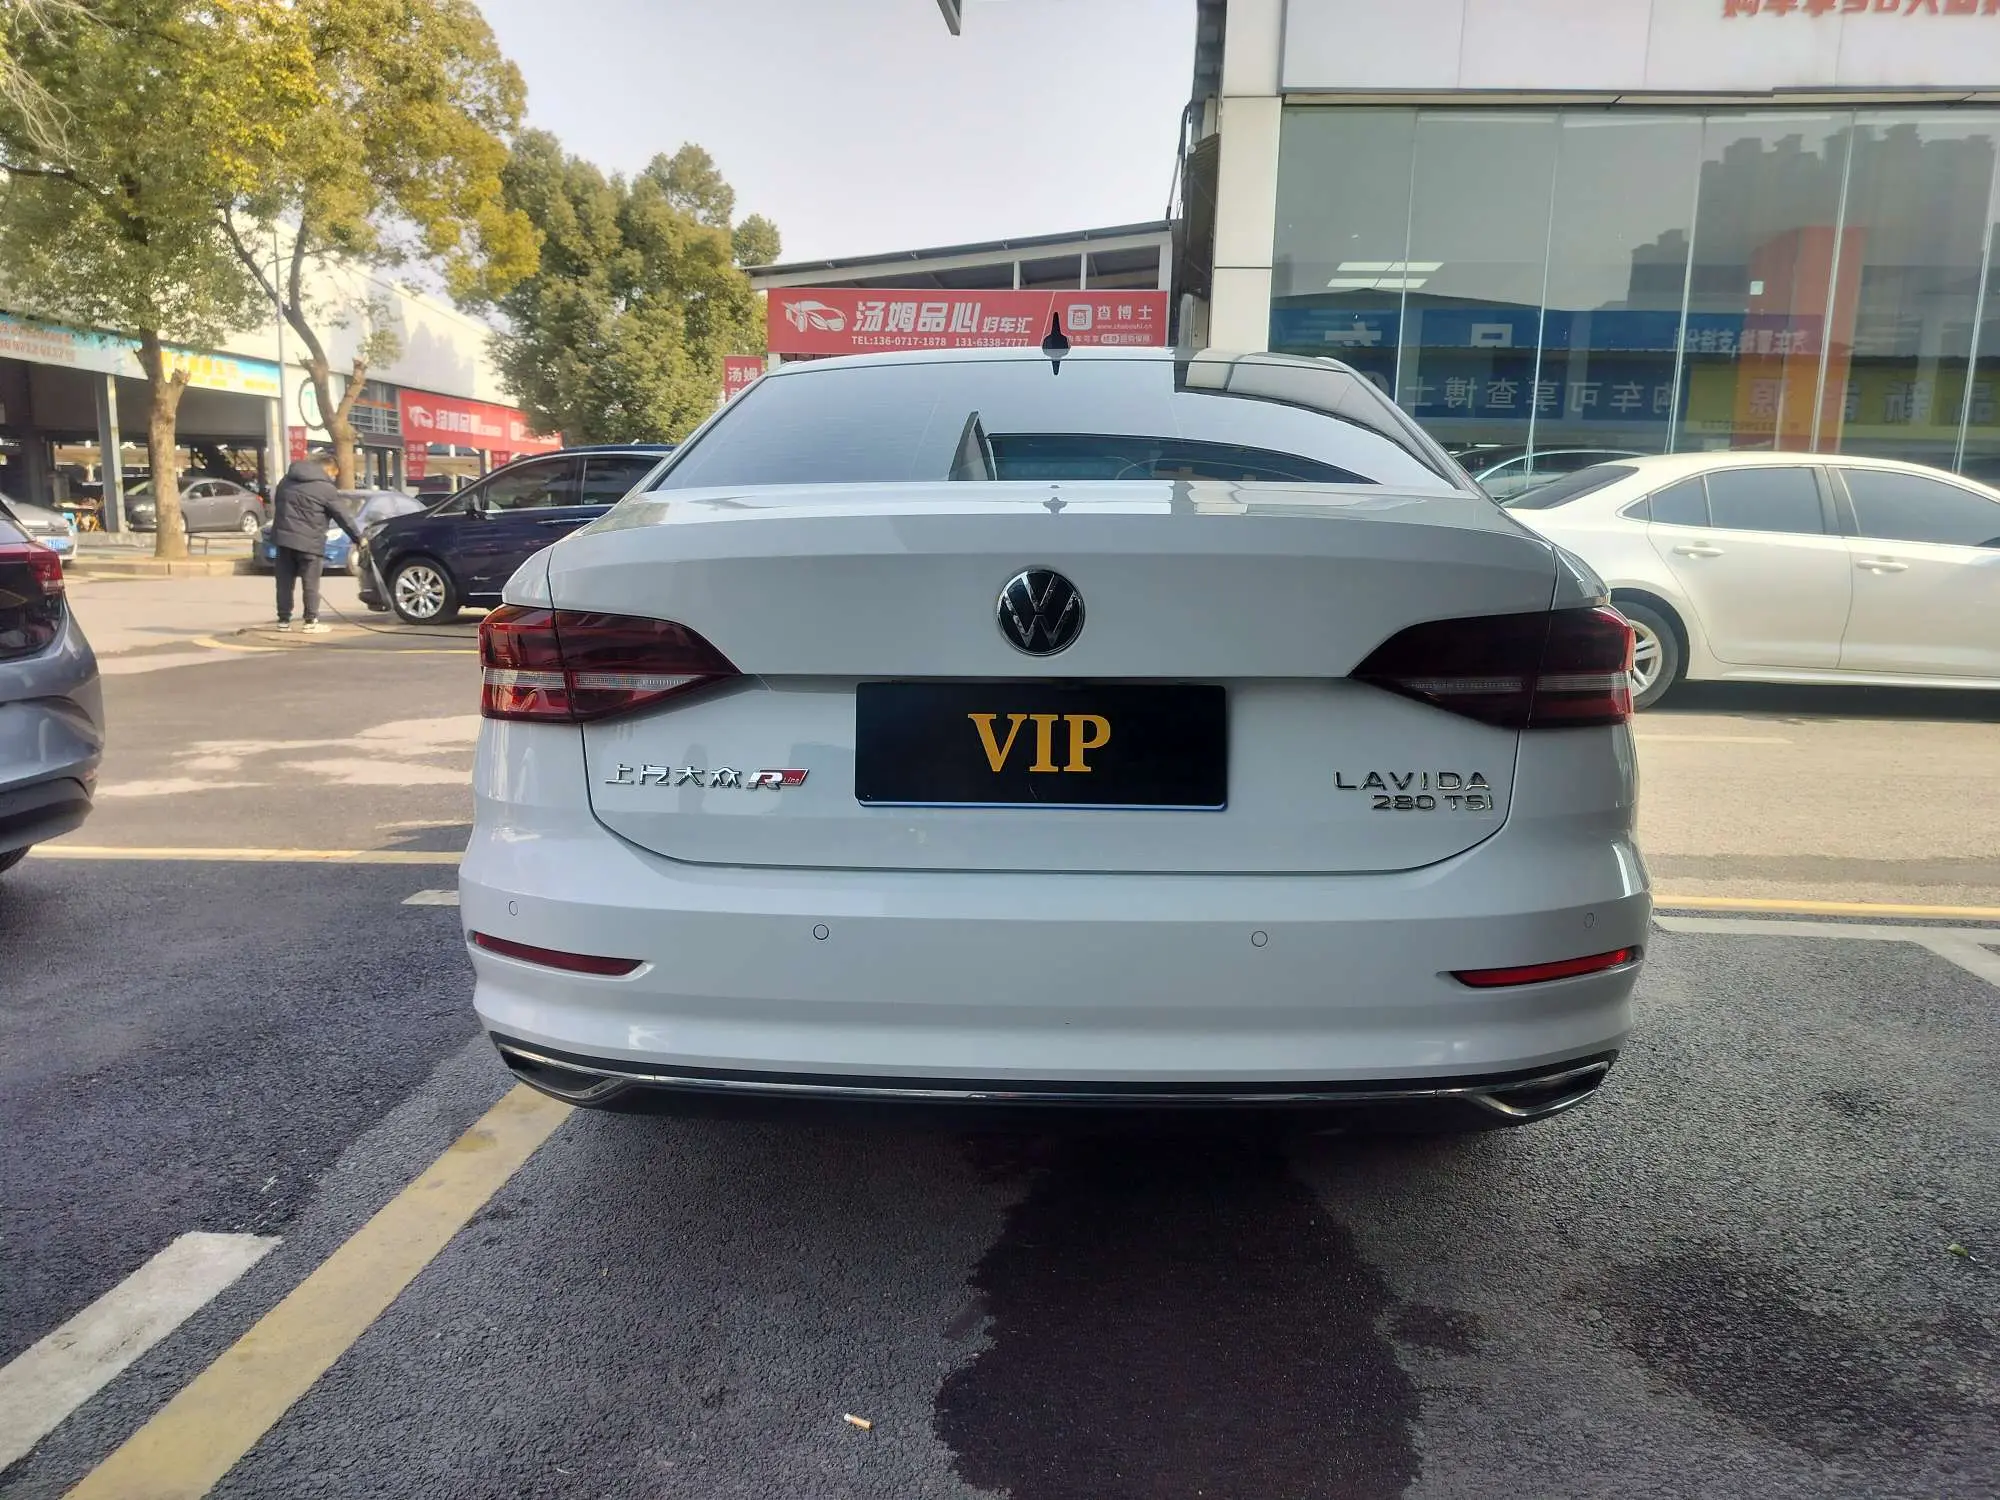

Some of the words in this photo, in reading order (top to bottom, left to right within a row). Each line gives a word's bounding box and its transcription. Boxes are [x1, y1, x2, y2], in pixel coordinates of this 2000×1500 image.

[853, 301, 981, 333] 汤姆品心
[852, 336, 947, 347] TEL:136-0717-1878
[967, 713, 1111, 773] VIP
[605, 763, 742, 789] 上汽大众
[1334, 771, 1491, 790] LAVIDA
[1371, 794, 1436, 811] 280
[1442, 794, 1494, 811] TSI
